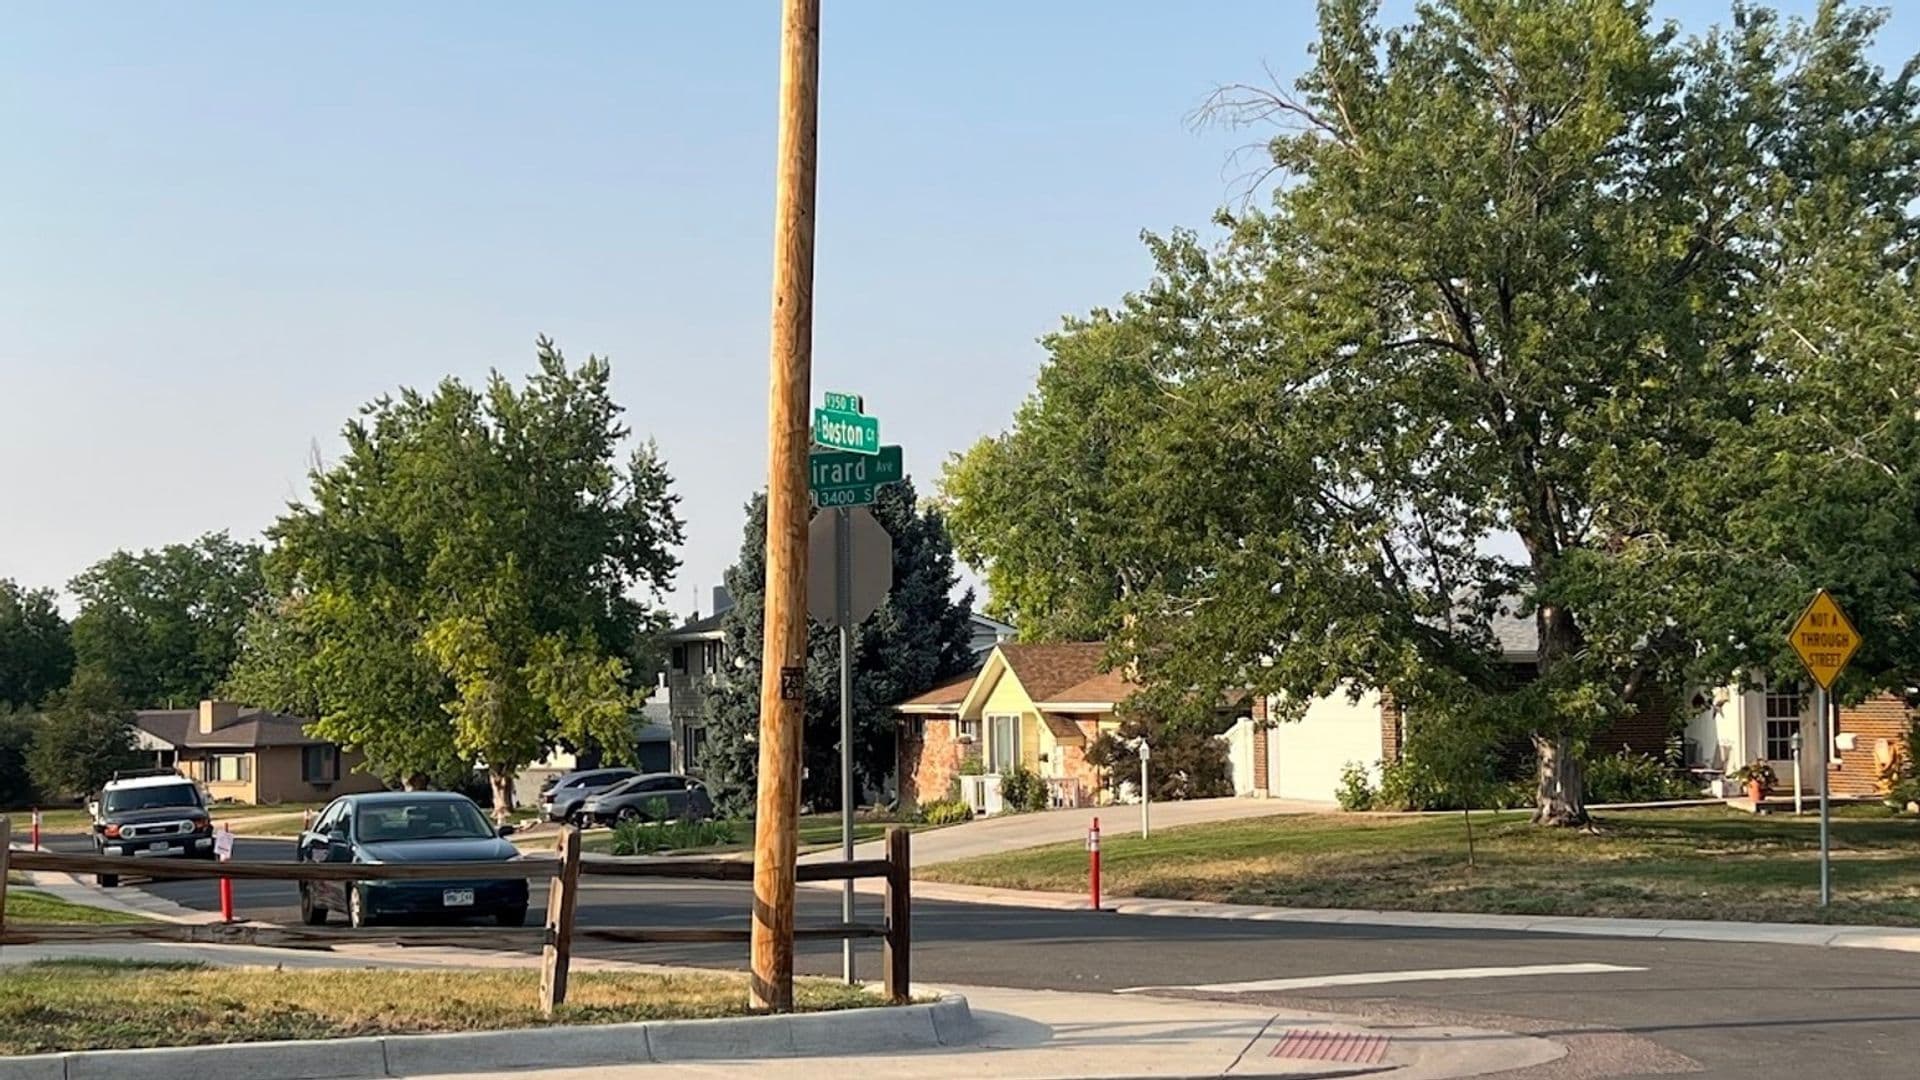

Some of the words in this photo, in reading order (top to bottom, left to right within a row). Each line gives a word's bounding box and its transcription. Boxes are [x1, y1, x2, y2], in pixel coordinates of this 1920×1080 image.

[850, 397, 856, 412] E
[821, 414, 863, 447] Boston
[812, 456, 865, 485] irard
[876, 461, 893, 473] Ave
[821, 489, 855, 505] 3400
[864, 488, 872, 502] S
[1810, 613, 1828, 627] NOT
[1831, 614, 1838, 627] A
[1801, 632, 1850, 648] THROUGH
[1808, 652, 1841, 668] STREET
